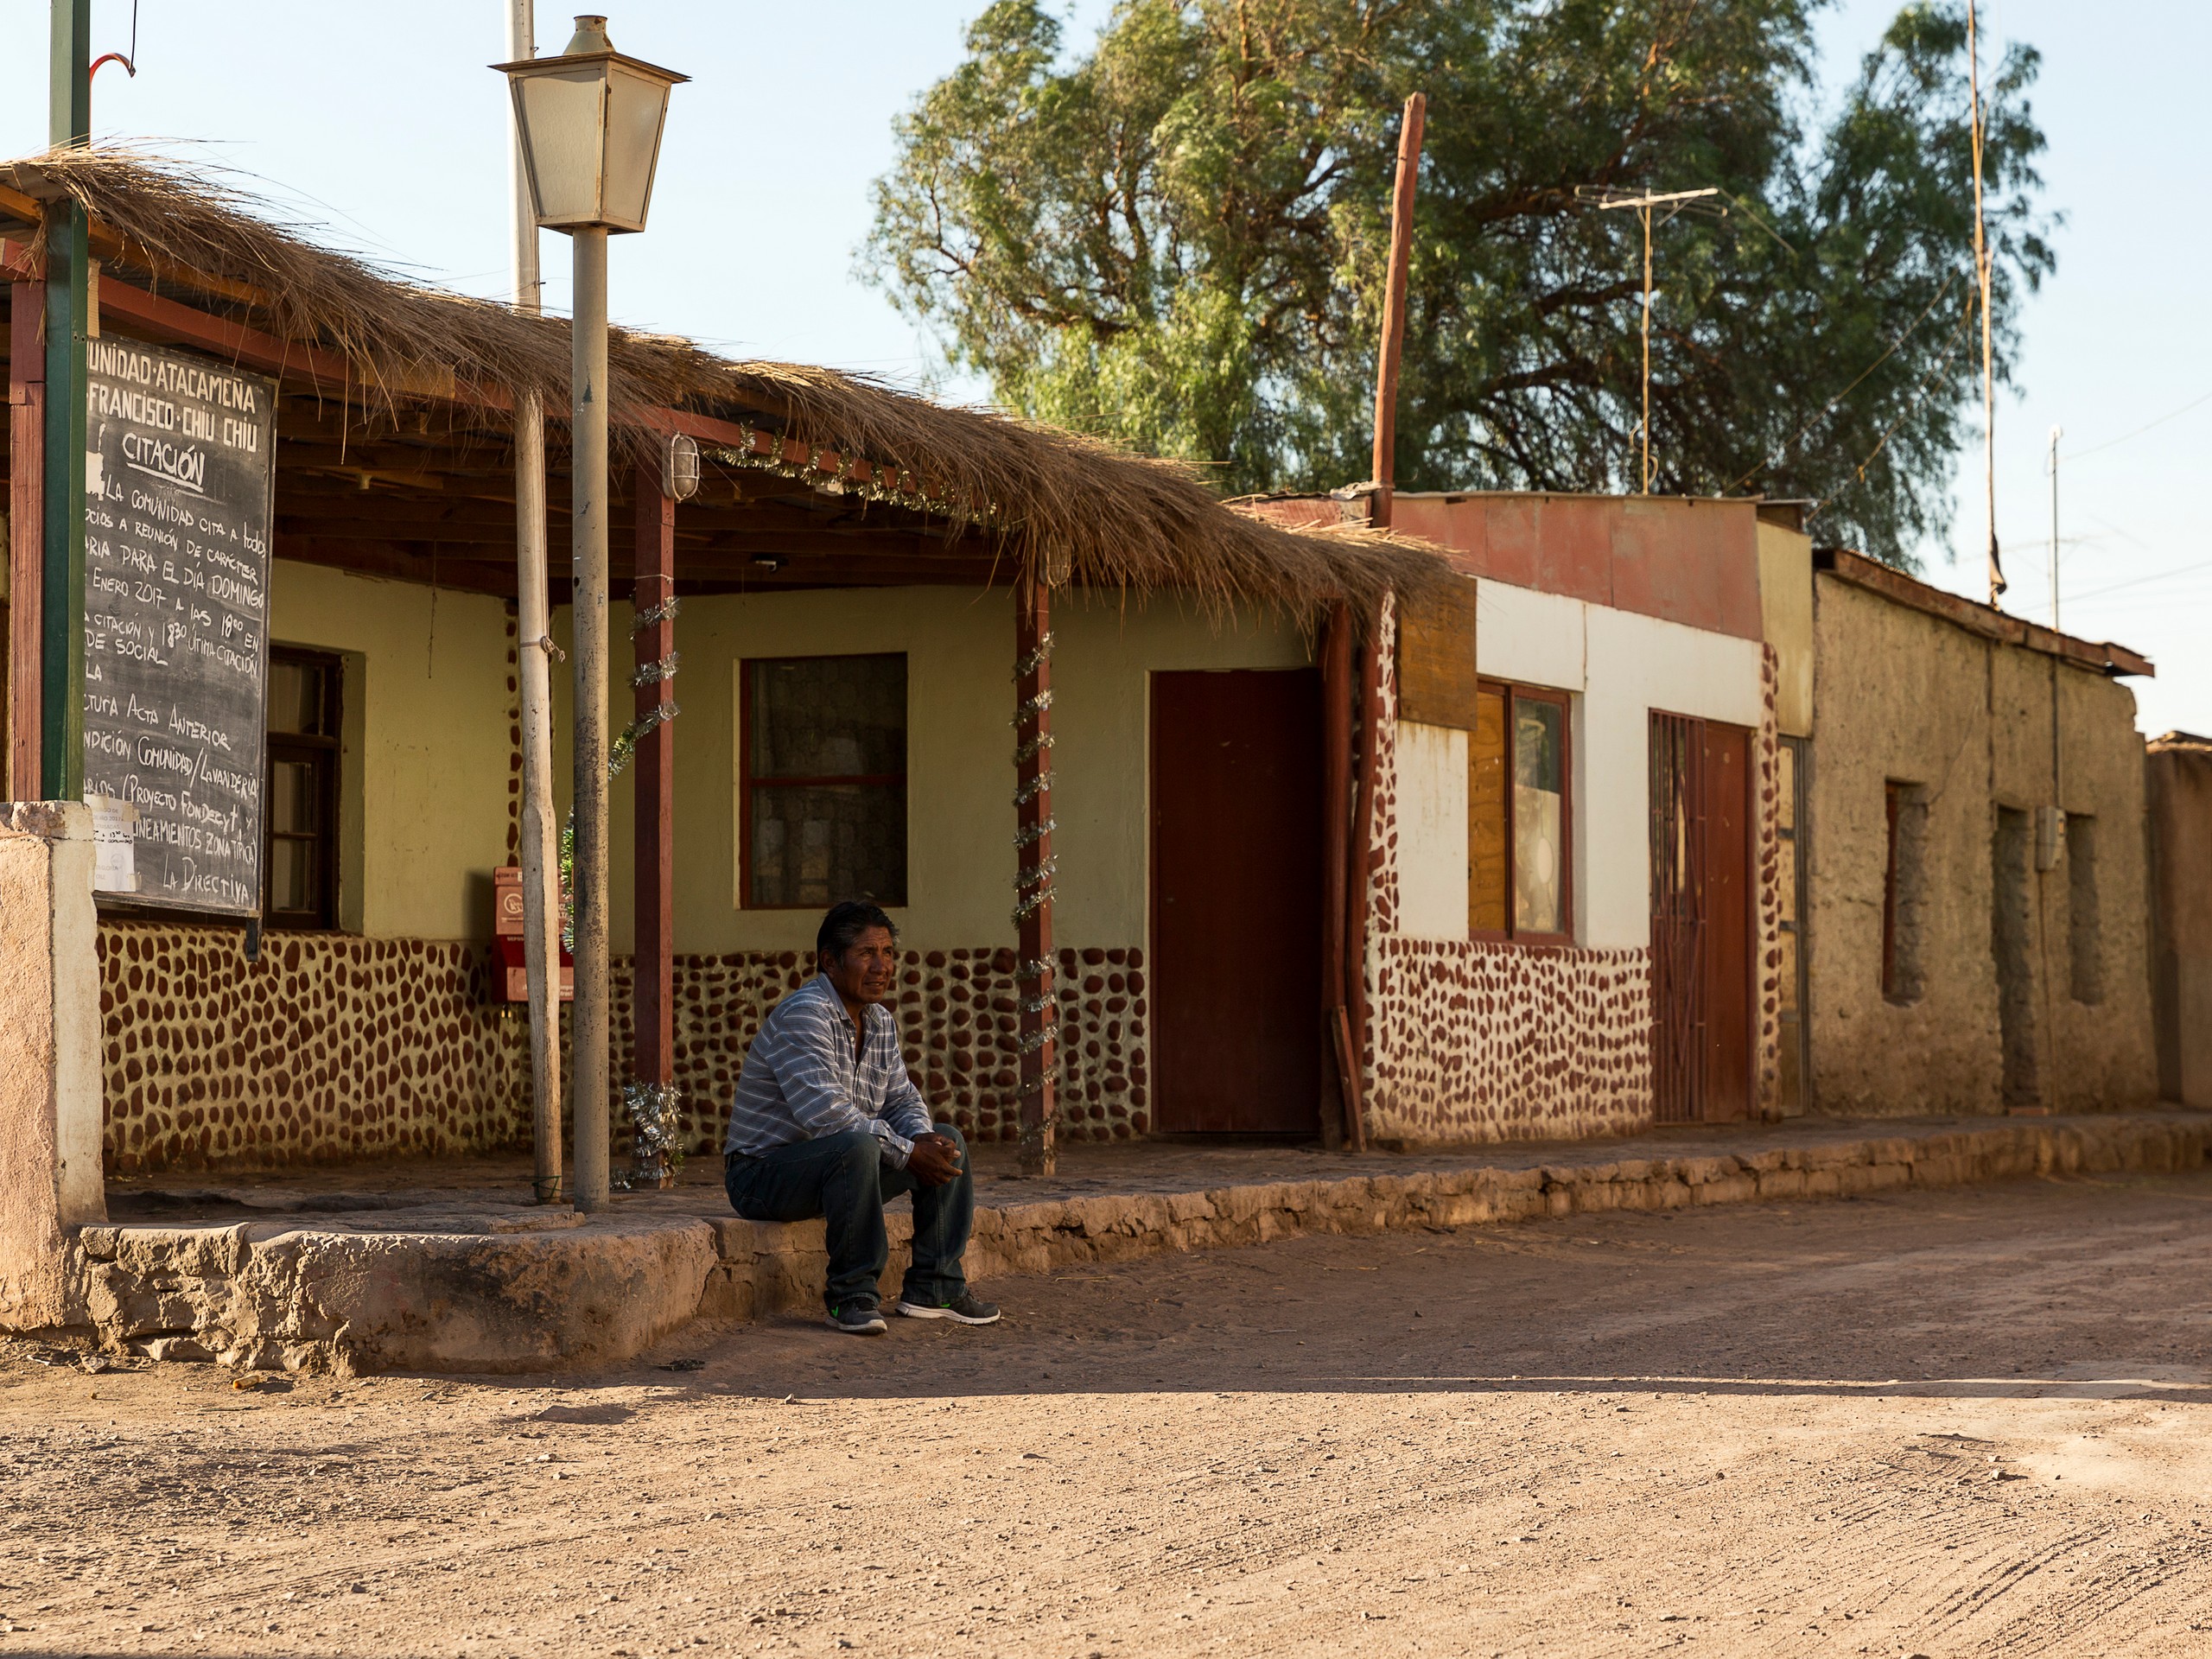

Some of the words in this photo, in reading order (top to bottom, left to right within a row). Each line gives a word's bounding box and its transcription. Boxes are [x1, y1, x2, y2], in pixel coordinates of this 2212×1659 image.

[87, 340, 151, 385] UNIDAD
[156, 359, 256, 414] ATACAMEÑA
[88, 381, 174, 431] FRANCISCO
[181, 404, 215, 442] CHIU
[223, 416, 257, 453] CHIU
[122, 432, 206, 486] CITACIÓN
[105, 474, 124, 502] LA
[131, 489, 194, 527] COMUNIDAD
[199, 518, 226, 536] CITA
[230, 528, 238, 543] A
[118, 518, 128, 532] A
[135, 520, 179, 552] REUNIÓN
[187, 539, 202, 558] DE
[207, 549, 258, 586] CARÁCTER
[119, 544, 158, 575] PARA
[162, 560, 180, 584] EL
[183, 561, 206, 592] DÍA
[211, 575, 264, 609] DOMINGO
[93, 567, 129, 597] ENERO
[134, 581, 168, 608] 2017
[175, 597, 185, 612] A
[244, 632, 259, 652] EN
[94, 612, 142, 640] CITACIÓN
[216, 645, 258, 678] CITACIÓN
[115, 638, 168, 666] SOCIAL
[127, 693, 159, 724] ACTA
[168, 703, 232, 751] ANTERIOR
[206, 832, 231, 857] ZONA
[163, 854, 178, 891] LA
[181, 856, 250, 905] DIRECTIVA
